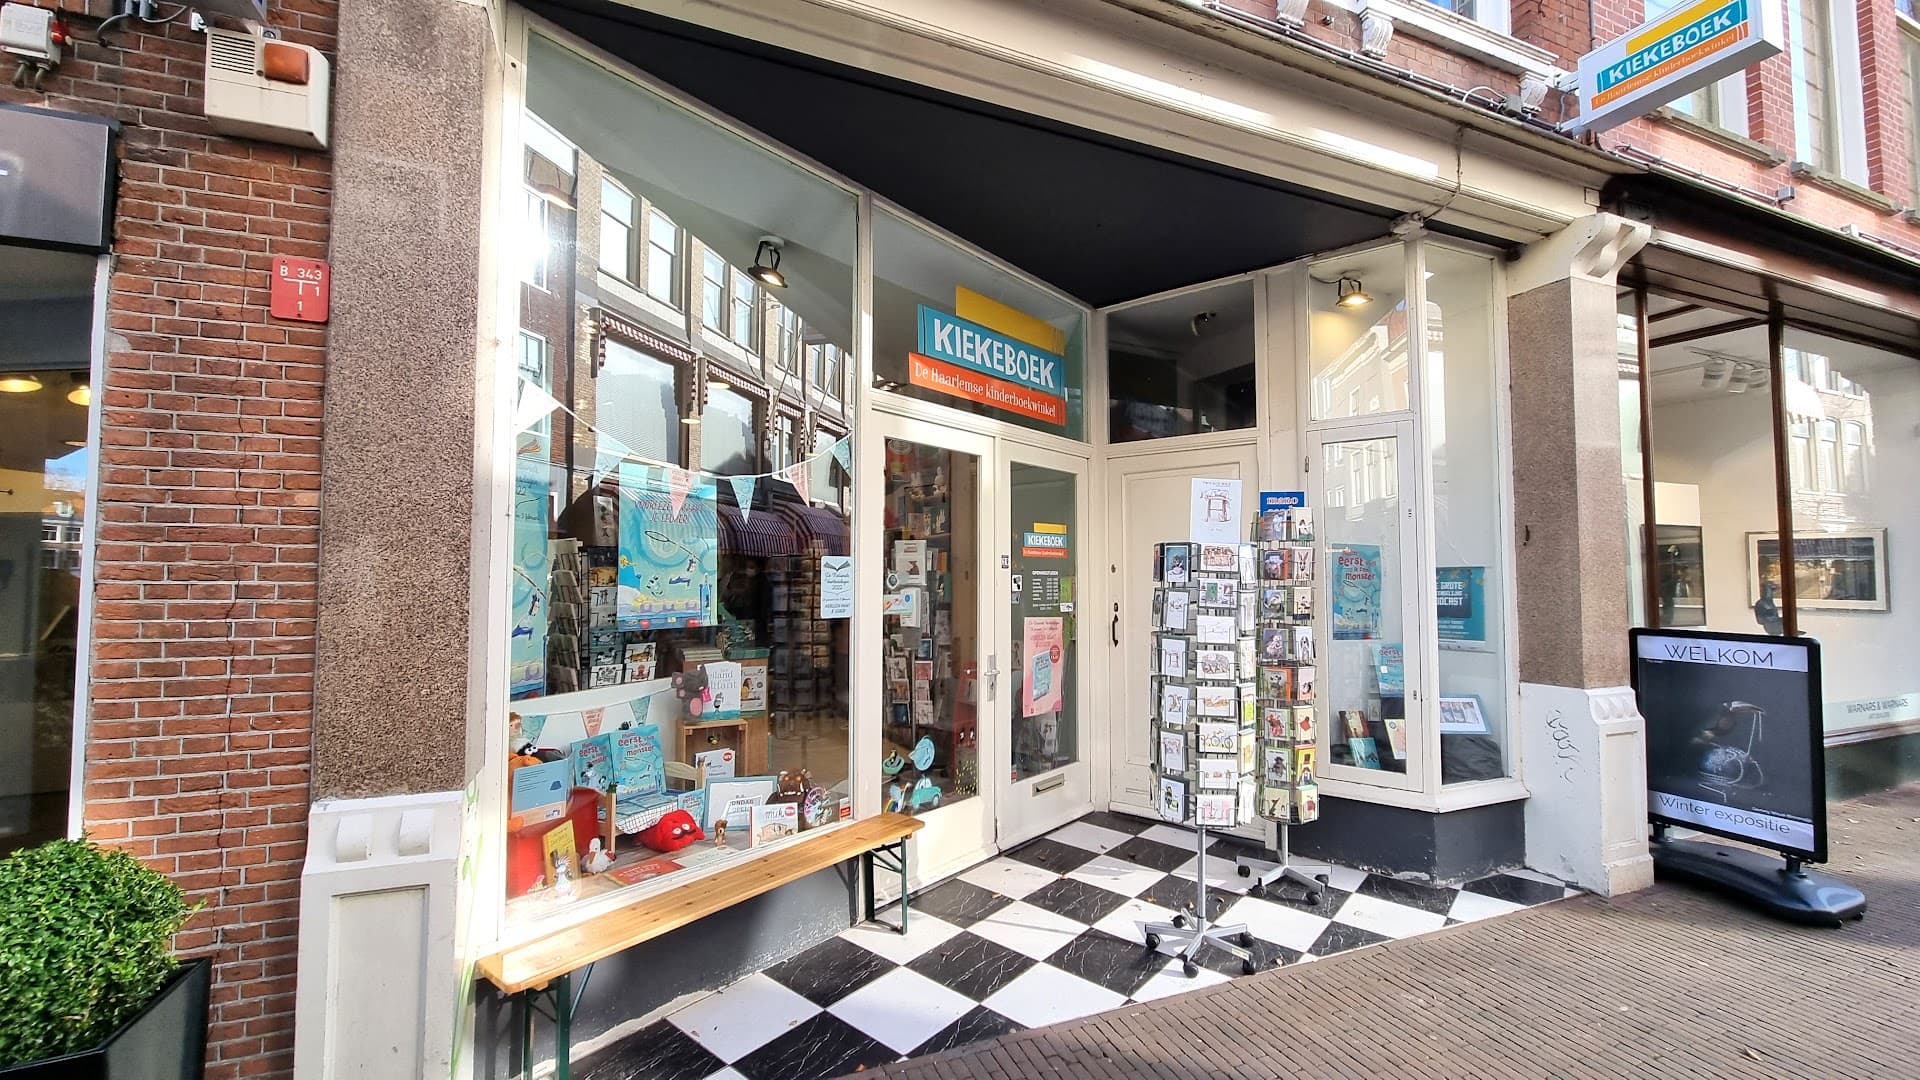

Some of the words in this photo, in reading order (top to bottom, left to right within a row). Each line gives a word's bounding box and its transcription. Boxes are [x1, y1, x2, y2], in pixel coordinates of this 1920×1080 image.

[1608, 9, 1732, 84] KIEKEBOEK
[280, 265, 289, 277] B
[297, 268, 322, 280] 343
[314, 286, 320, 297] 1
[297, 300, 303, 311] 1
[934, 318, 1055, 389] KIEKEBOEK
[914, 362, 929, 379] De
[931, 369, 984, 395] Haarlemse
[985, 383, 1057, 418] kinderboekwinkel
[1028, 535, 1064, 546] KIEKEBOEK
[1338, 556, 1363, 567] eerst
[1345, 572, 1375, 581] monster
[1440, 581, 1464, 590] GROTE
[1664, 643, 1774, 667] WELKOM
[1659, 794, 1712, 816] Winter
[1714, 809, 1791, 834] expositie
